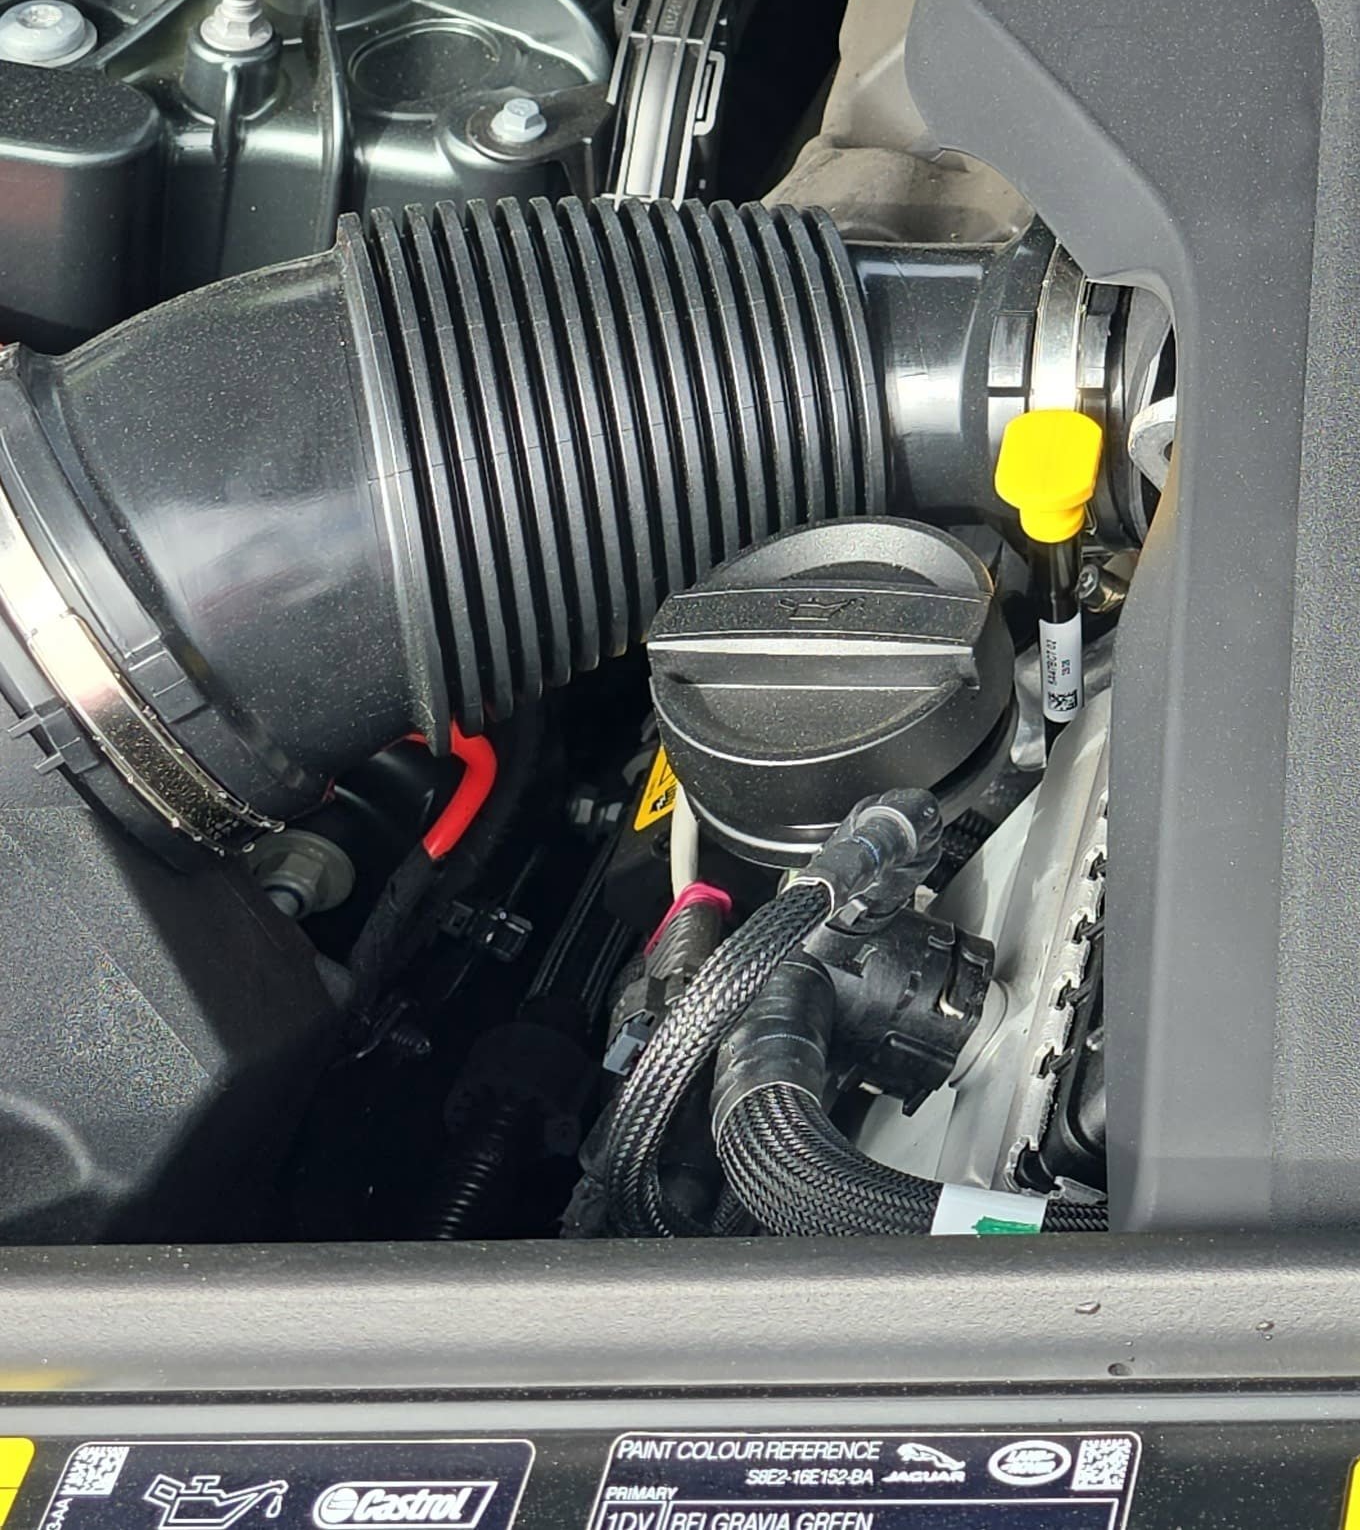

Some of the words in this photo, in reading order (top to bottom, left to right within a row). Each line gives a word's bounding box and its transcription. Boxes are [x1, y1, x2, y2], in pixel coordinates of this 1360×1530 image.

[616, 1440, 677, 1460] PAINT
[677, 1440, 764, 1460] COLOUR
[765, 1440, 883, 1460] REFERENCE
[881, 1471, 966, 1483] JAGUAR
[605, 1486, 678, 1500] PRIMARY
[353, 1488, 474, 1521] Castrol
